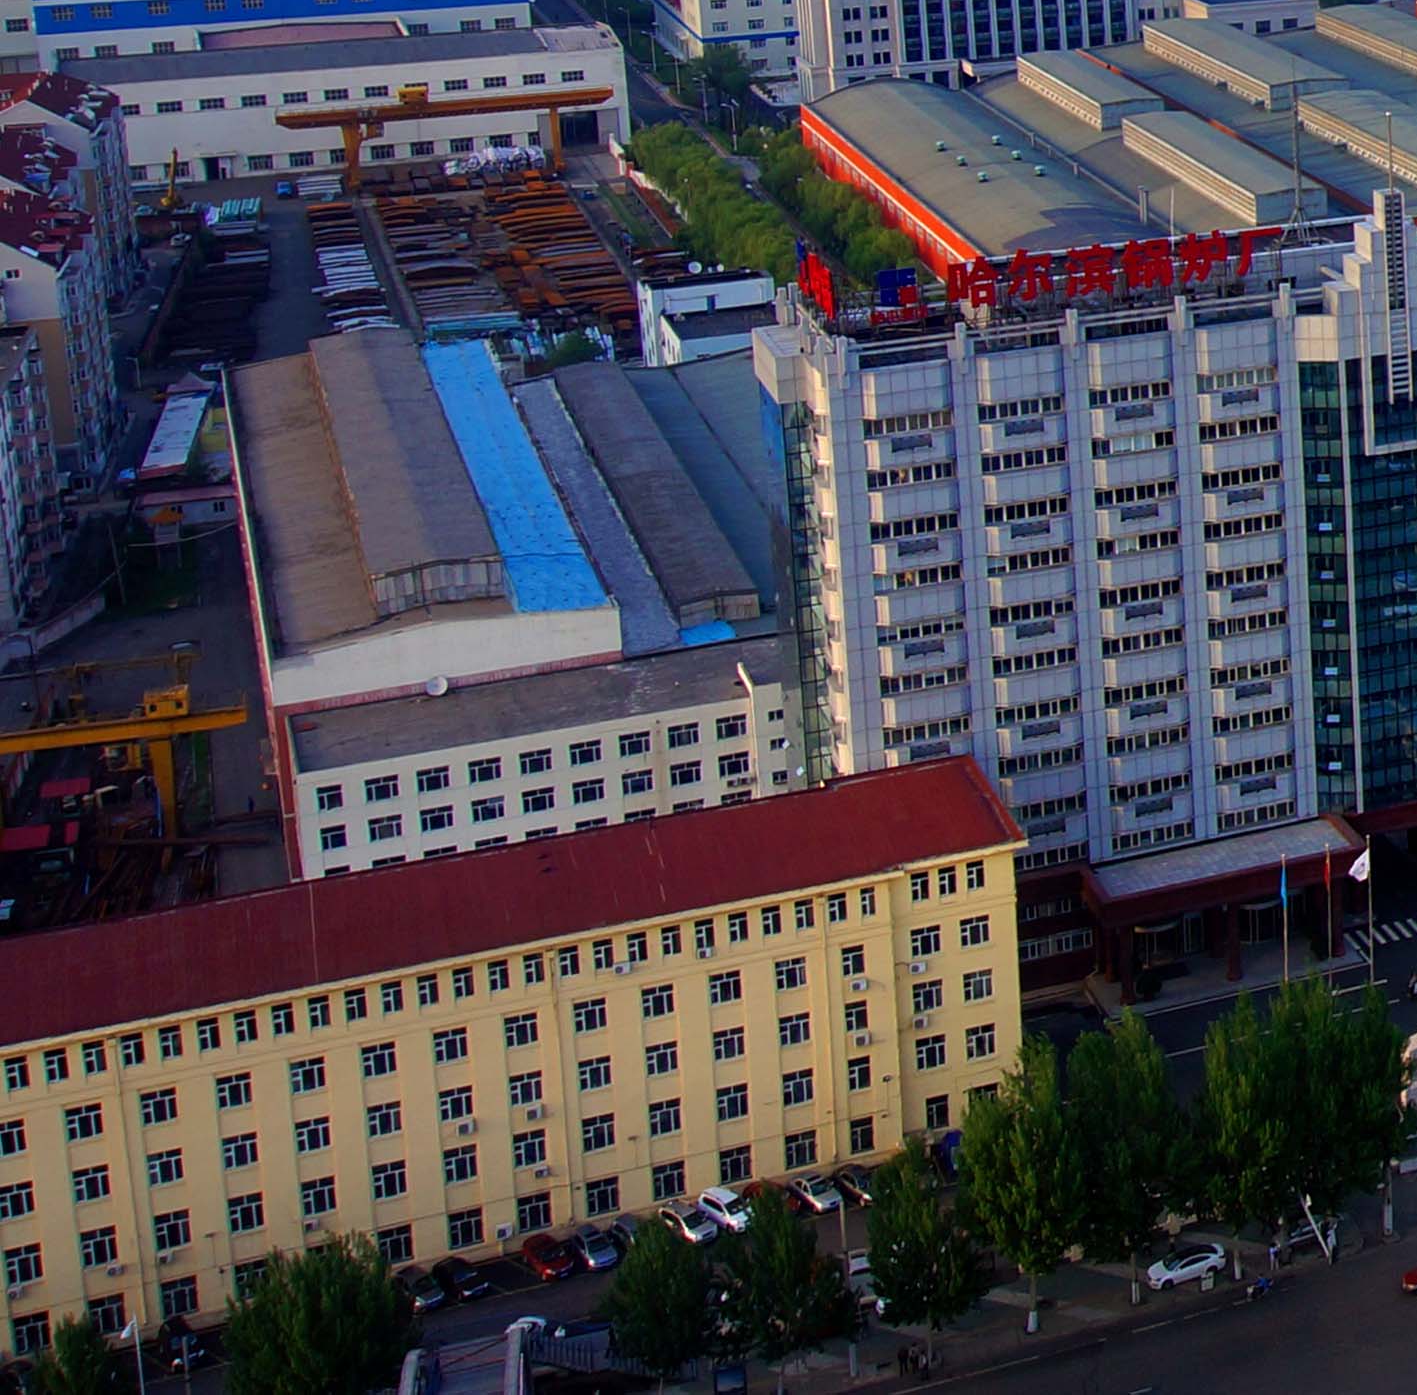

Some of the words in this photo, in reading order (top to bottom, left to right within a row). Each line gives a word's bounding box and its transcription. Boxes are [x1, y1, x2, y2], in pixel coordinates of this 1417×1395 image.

[947, 227, 1283, 307] 哈尔滨锅炉厂
